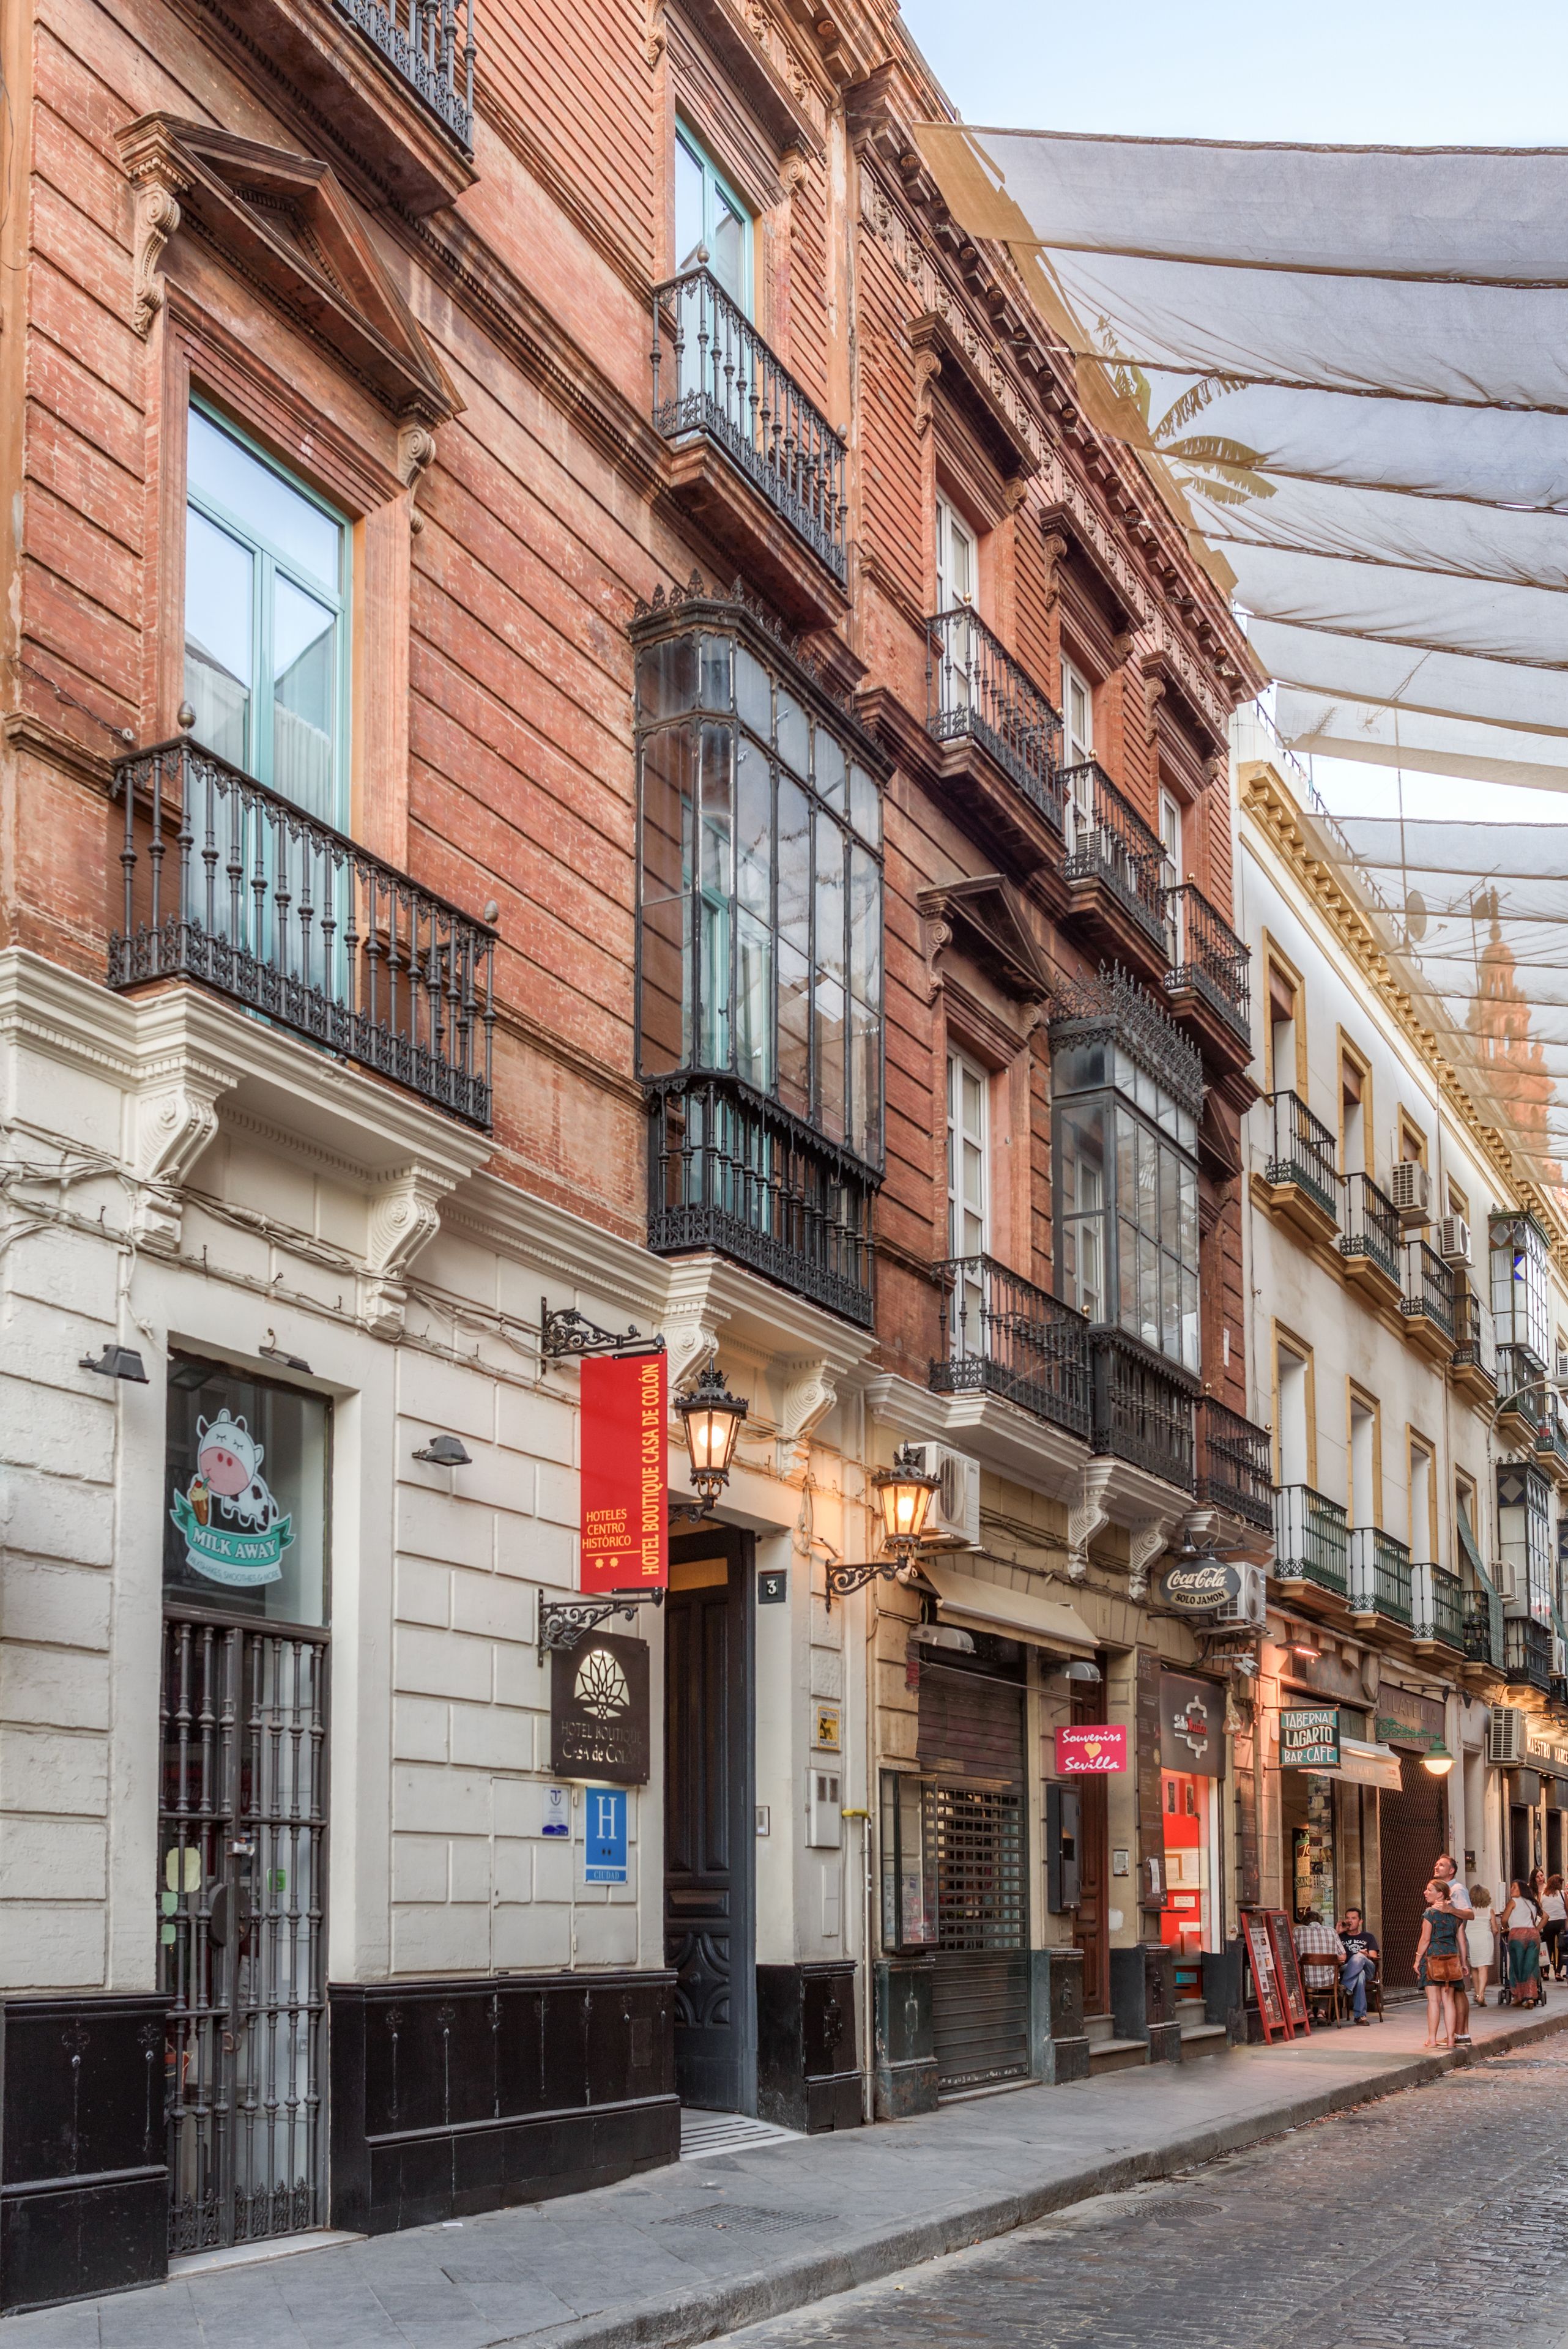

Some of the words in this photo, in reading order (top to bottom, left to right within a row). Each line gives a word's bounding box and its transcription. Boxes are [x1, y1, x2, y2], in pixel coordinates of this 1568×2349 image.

[638, 1363, 660, 1406] COLÓN
[642, 1408, 660, 1427] DE
[642, 1428, 660, 1464] CASA
[642, 1466, 664, 1532] BOUTIQUE
[586, 1508, 627, 1522] HOTELES
[587, 1522, 625, 1535] CENTRO
[192, 1526, 232, 1557] MILK
[234, 1539, 276, 1559] AWAY
[582, 1534, 631, 1549] HISTÓRICO
[642, 1534, 660, 1576] HOTEL
[767, 1580, 777, 1595] 3
[1166, 1567, 1228, 1590] Coca-Cola
[1175, 1593, 1195, 1605] SOLO
[1196, 1590, 1225, 1605] JAMON
[1380, 1690, 1437, 1726] FILATELIA
[561, 1721, 592, 1739] HOTEL
[1284, 1713, 1328, 1729] TABERNA
[1062, 1729, 1121, 1743] Souvenirs
[1285, 1725, 1333, 1748] LAGARTO
[592, 1744, 604, 1762] de
[1527, 1736, 1550, 1759] MAESTRO
[1065, 1756, 1120, 1772] Sevilla
[596, 1796, 617, 1839] H
[593, 1869, 620, 1880] CIUDAD
